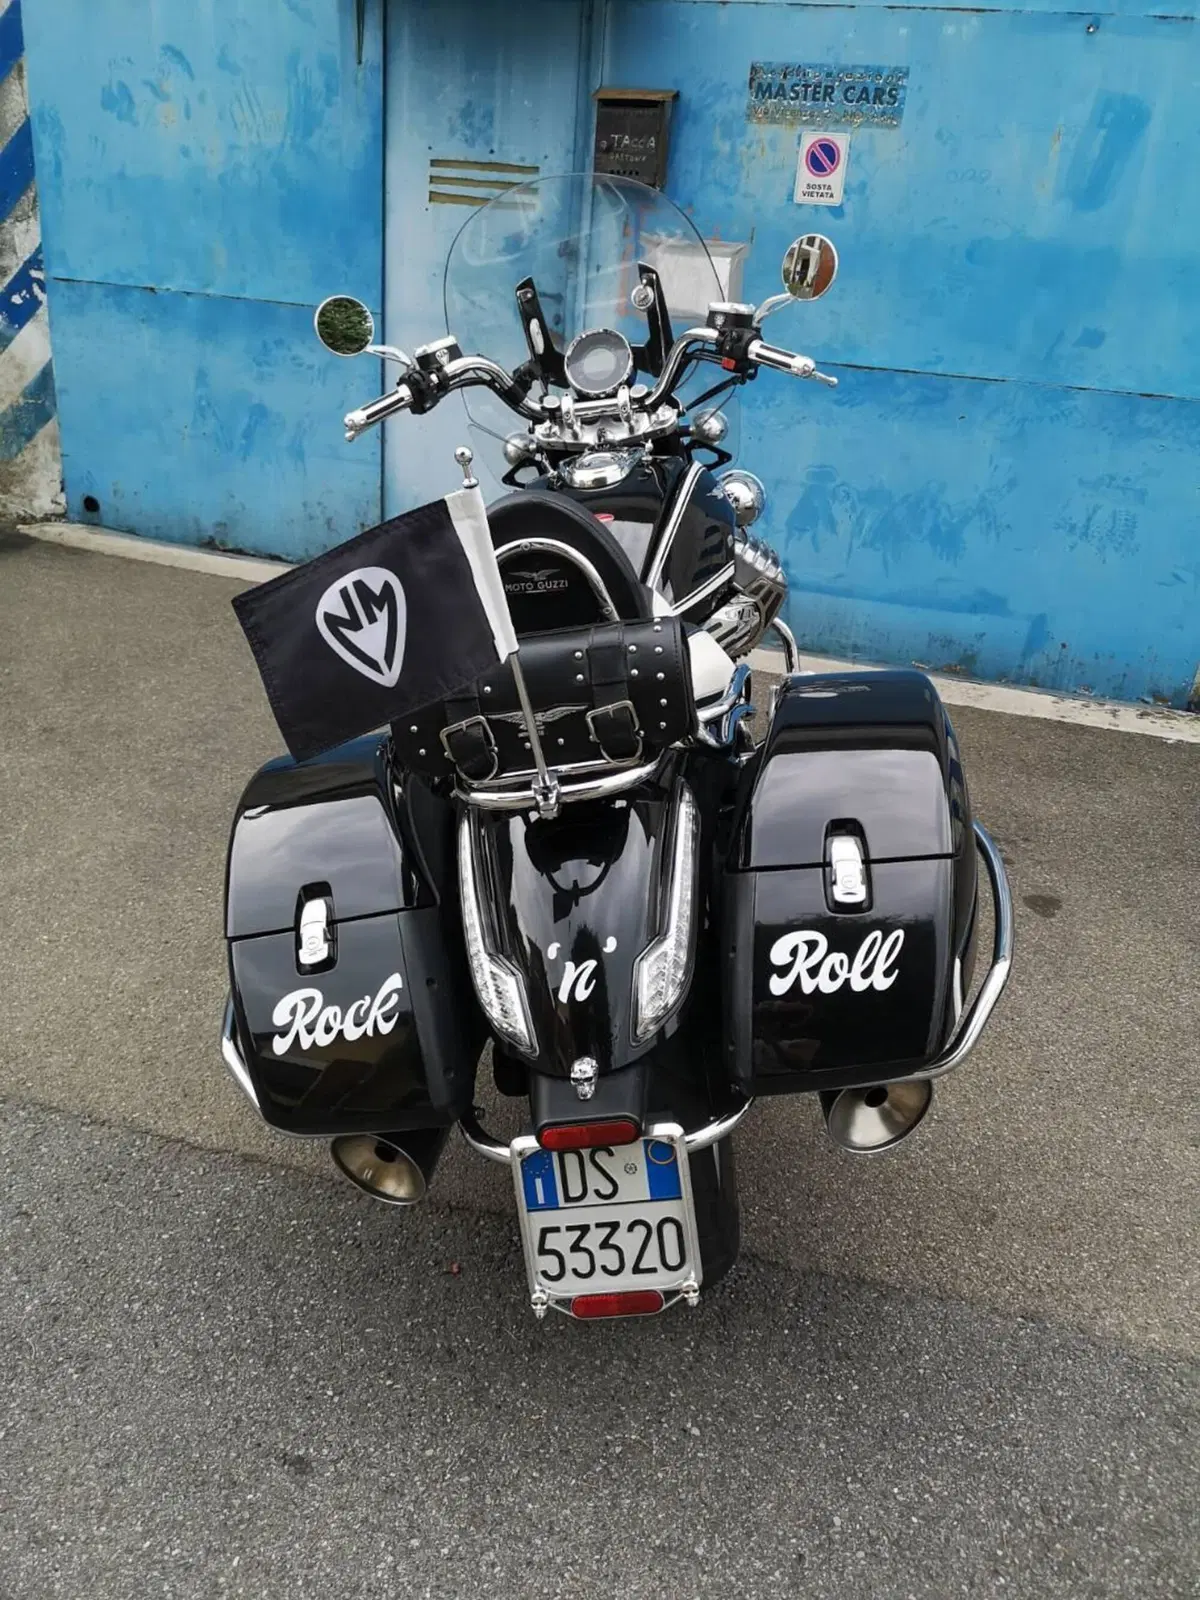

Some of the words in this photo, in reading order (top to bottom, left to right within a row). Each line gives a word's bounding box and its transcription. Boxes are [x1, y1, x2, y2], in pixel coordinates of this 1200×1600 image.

[754, 81, 835, 102] MASTER
[843, 85, 899, 105] CARS
[801, 190, 835, 199] VIETATA
[806, 182, 832, 191] SOSTA
[504, 581, 534, 592] MOTO
[537, 578, 569, 590] GUZZI
[272, 972, 403, 1056] Rock
[769, 928, 905, 996] Roll
[558, 1147, 619, 1203] DS
[537, 1216, 687, 1282] 53320
